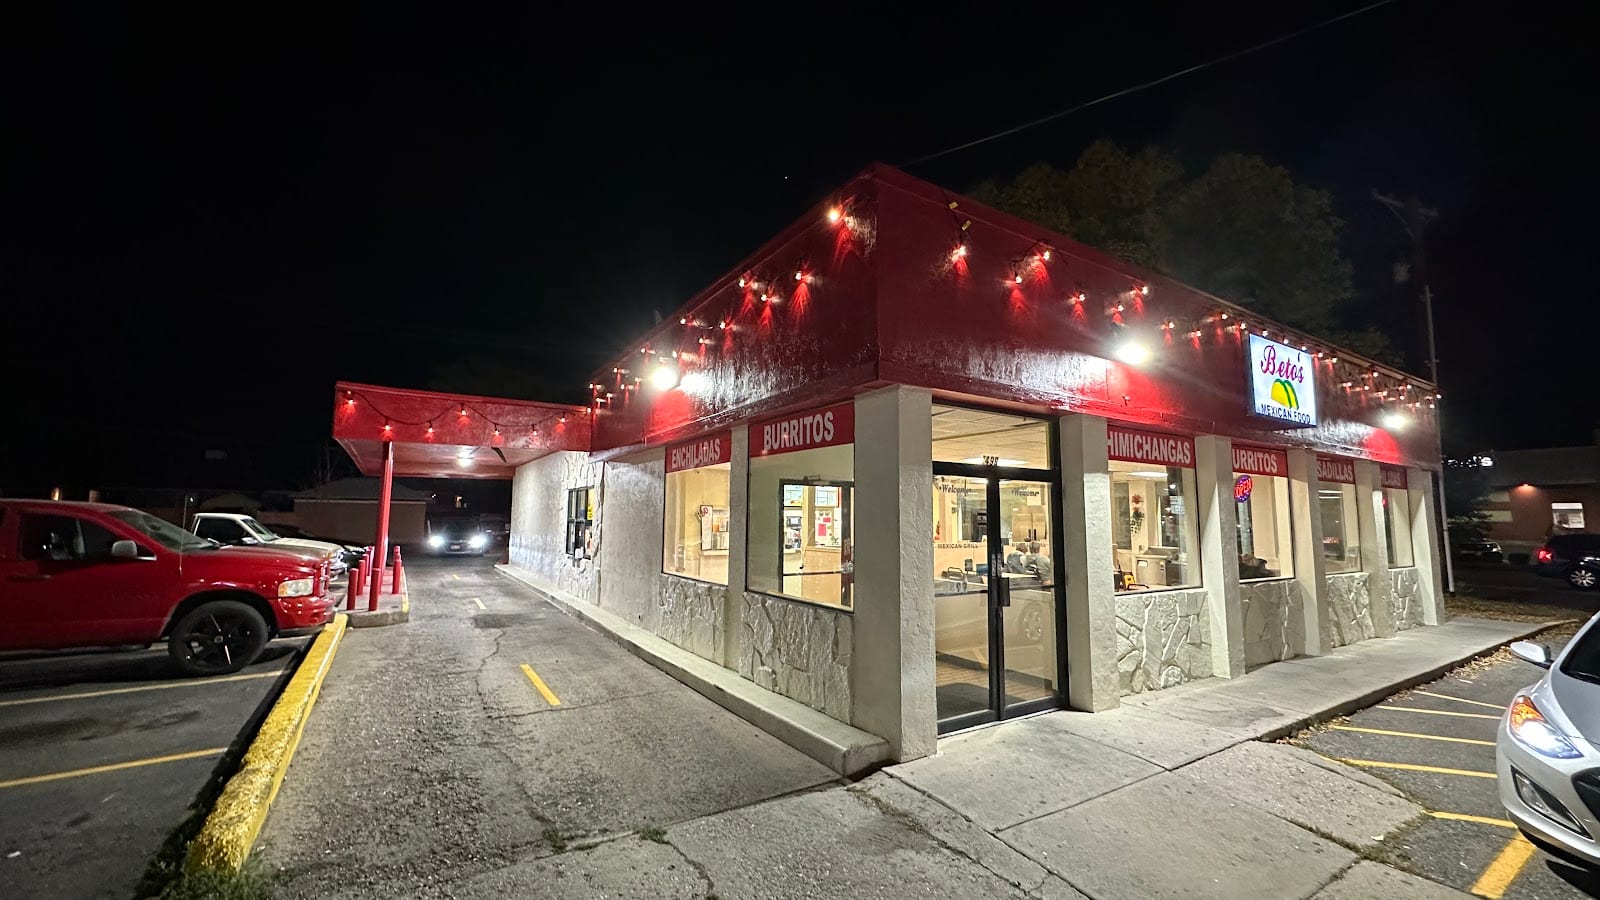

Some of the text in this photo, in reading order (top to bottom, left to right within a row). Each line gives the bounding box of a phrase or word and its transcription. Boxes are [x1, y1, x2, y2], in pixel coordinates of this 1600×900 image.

[1261, 345, 1304, 383] Beto's
[1261, 403, 1311, 424] MEXICAN FOOD
[764, 411, 834, 450] BURRITOS
[672, 438, 721, 469] ENCHILADAS
[1234, 478, 1252, 498] OPEN
